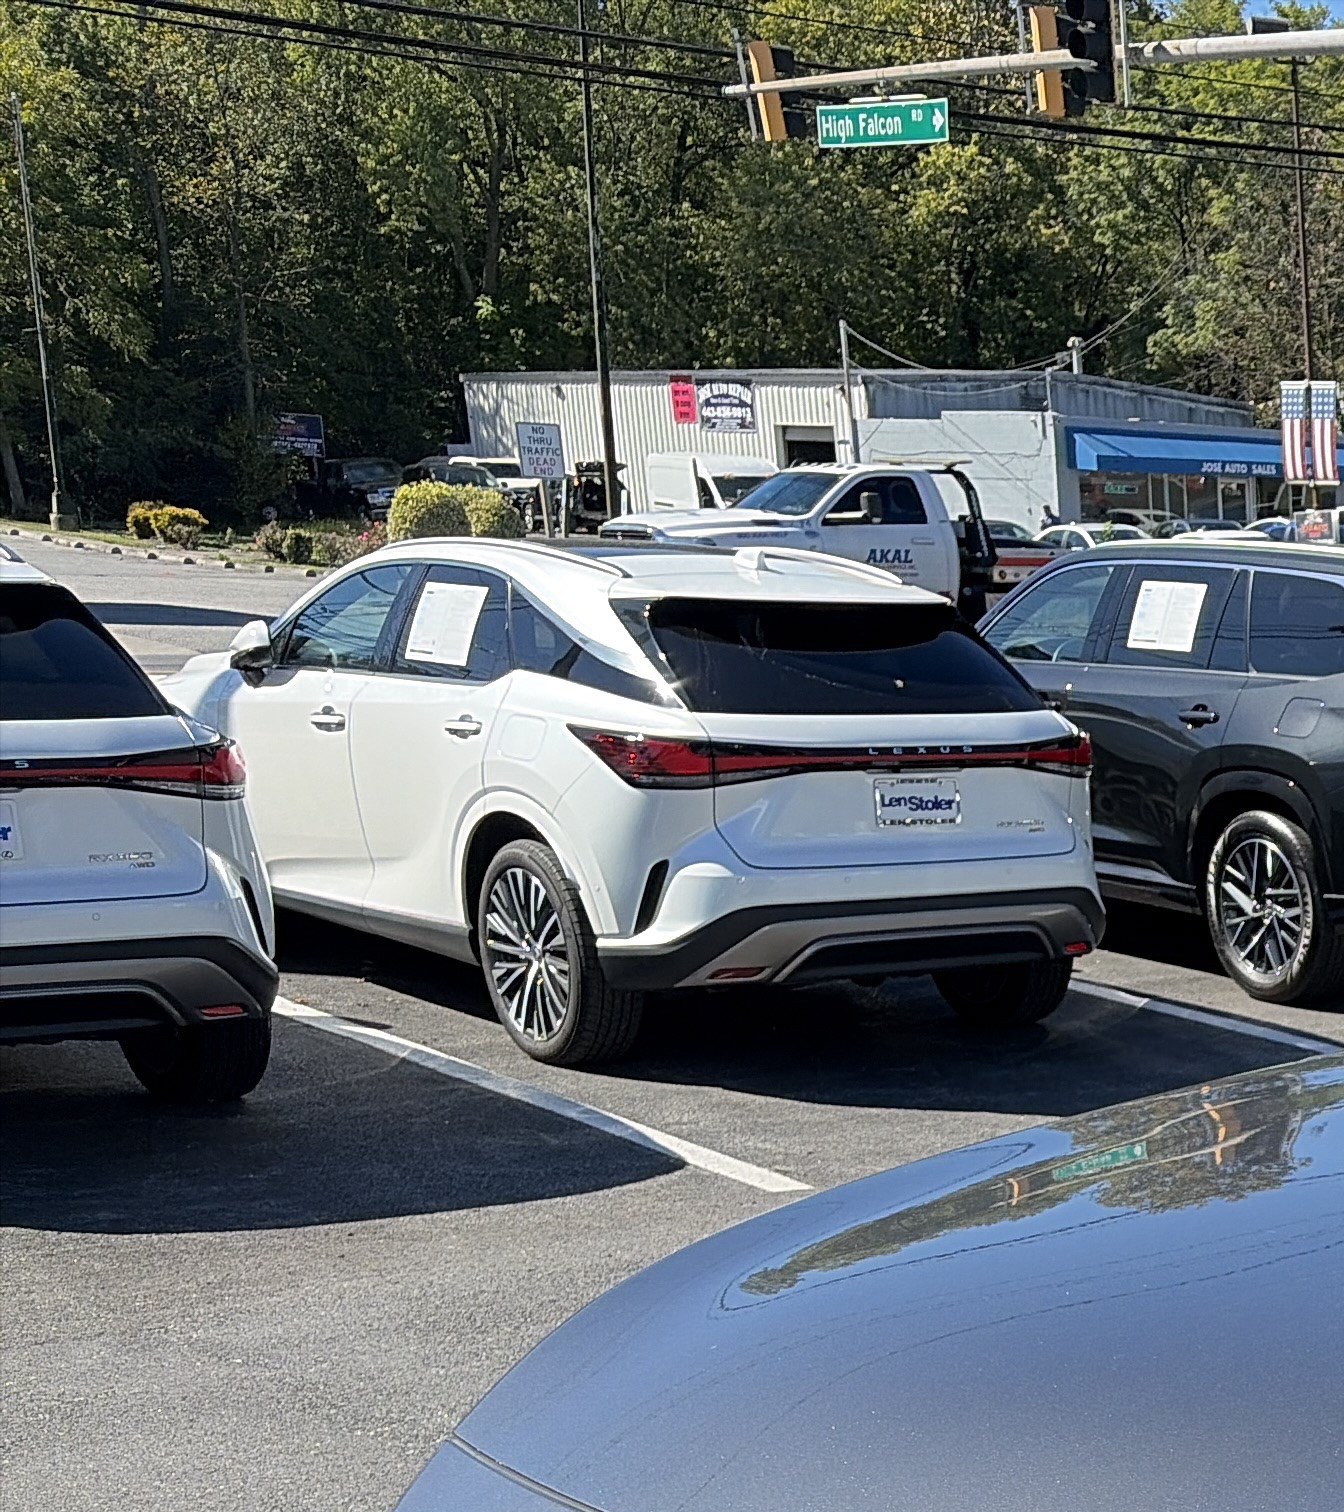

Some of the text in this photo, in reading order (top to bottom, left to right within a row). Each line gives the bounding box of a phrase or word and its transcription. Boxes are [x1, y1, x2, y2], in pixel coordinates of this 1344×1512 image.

[821, 109, 923, 143] High Falcon RD
[531, 426, 545, 435] NO
[527, 436, 552, 446] THRU
[522, 446, 561, 457] TRAFFIC
[529, 457, 556, 467] DEAD
[533, 467, 554, 476] END
[1225, 463, 1248, 474] AUTO
[1252, 464, 1276, 476] SALES
[866, 549, 913, 564] AKAL
[869, 745, 972, 755] LEXUS
[130, 861, 155, 869] AWD
